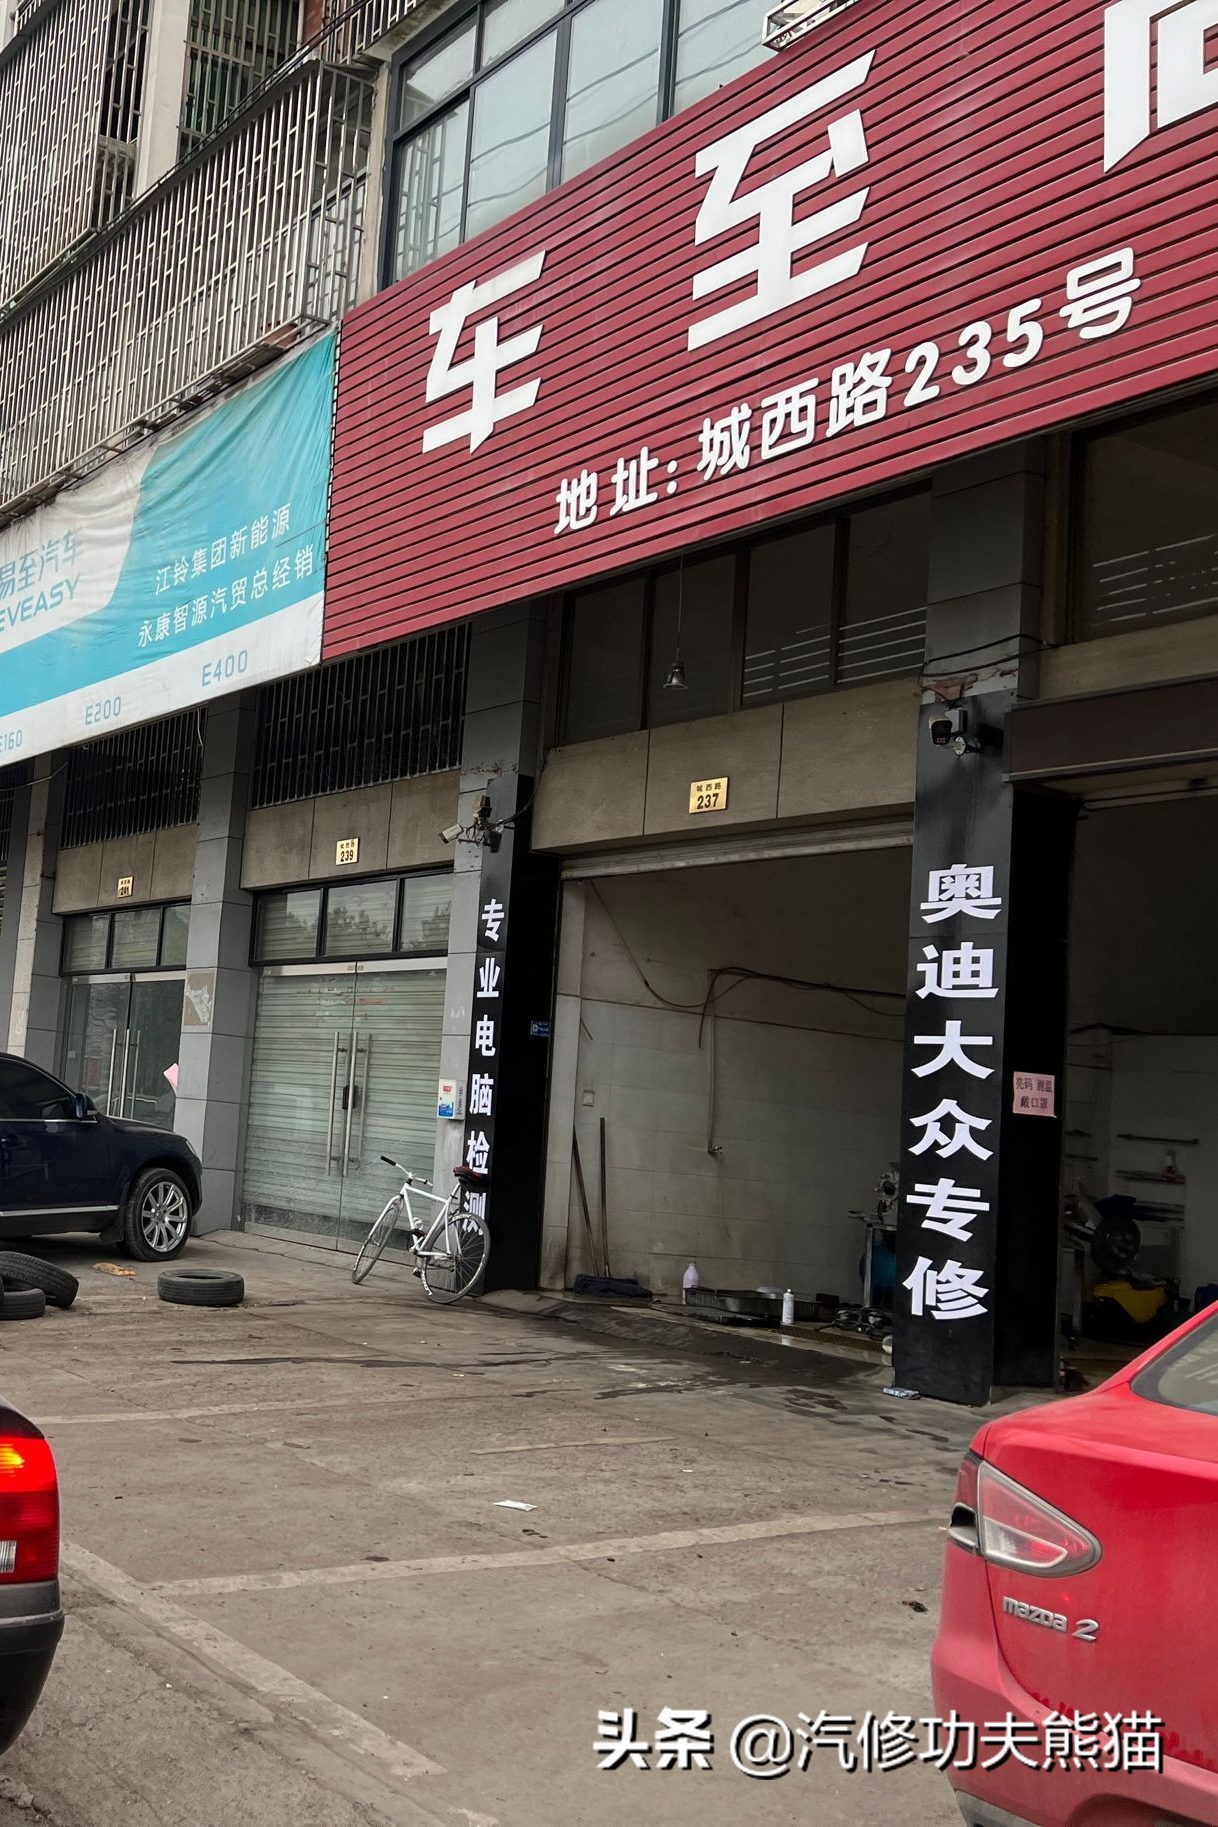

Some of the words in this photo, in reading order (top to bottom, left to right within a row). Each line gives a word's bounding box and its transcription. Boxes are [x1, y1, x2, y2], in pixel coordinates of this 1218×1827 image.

[155, 502, 292, 596] 江铃集团新能源
[138, 543, 314, 648] 永康智源汽贸总经销
[201, 649, 248, 687] E400
[85, 695, 122, 725] E200
[697, 793, 719, 809] 237
[340, 849, 354, 862] 239
[462, 898, 505, 1236] 专业电脑检测
[902, 863, 1001, 1320] 奥迪大众专修
[1072, 1618, 1099, 1641] 2
